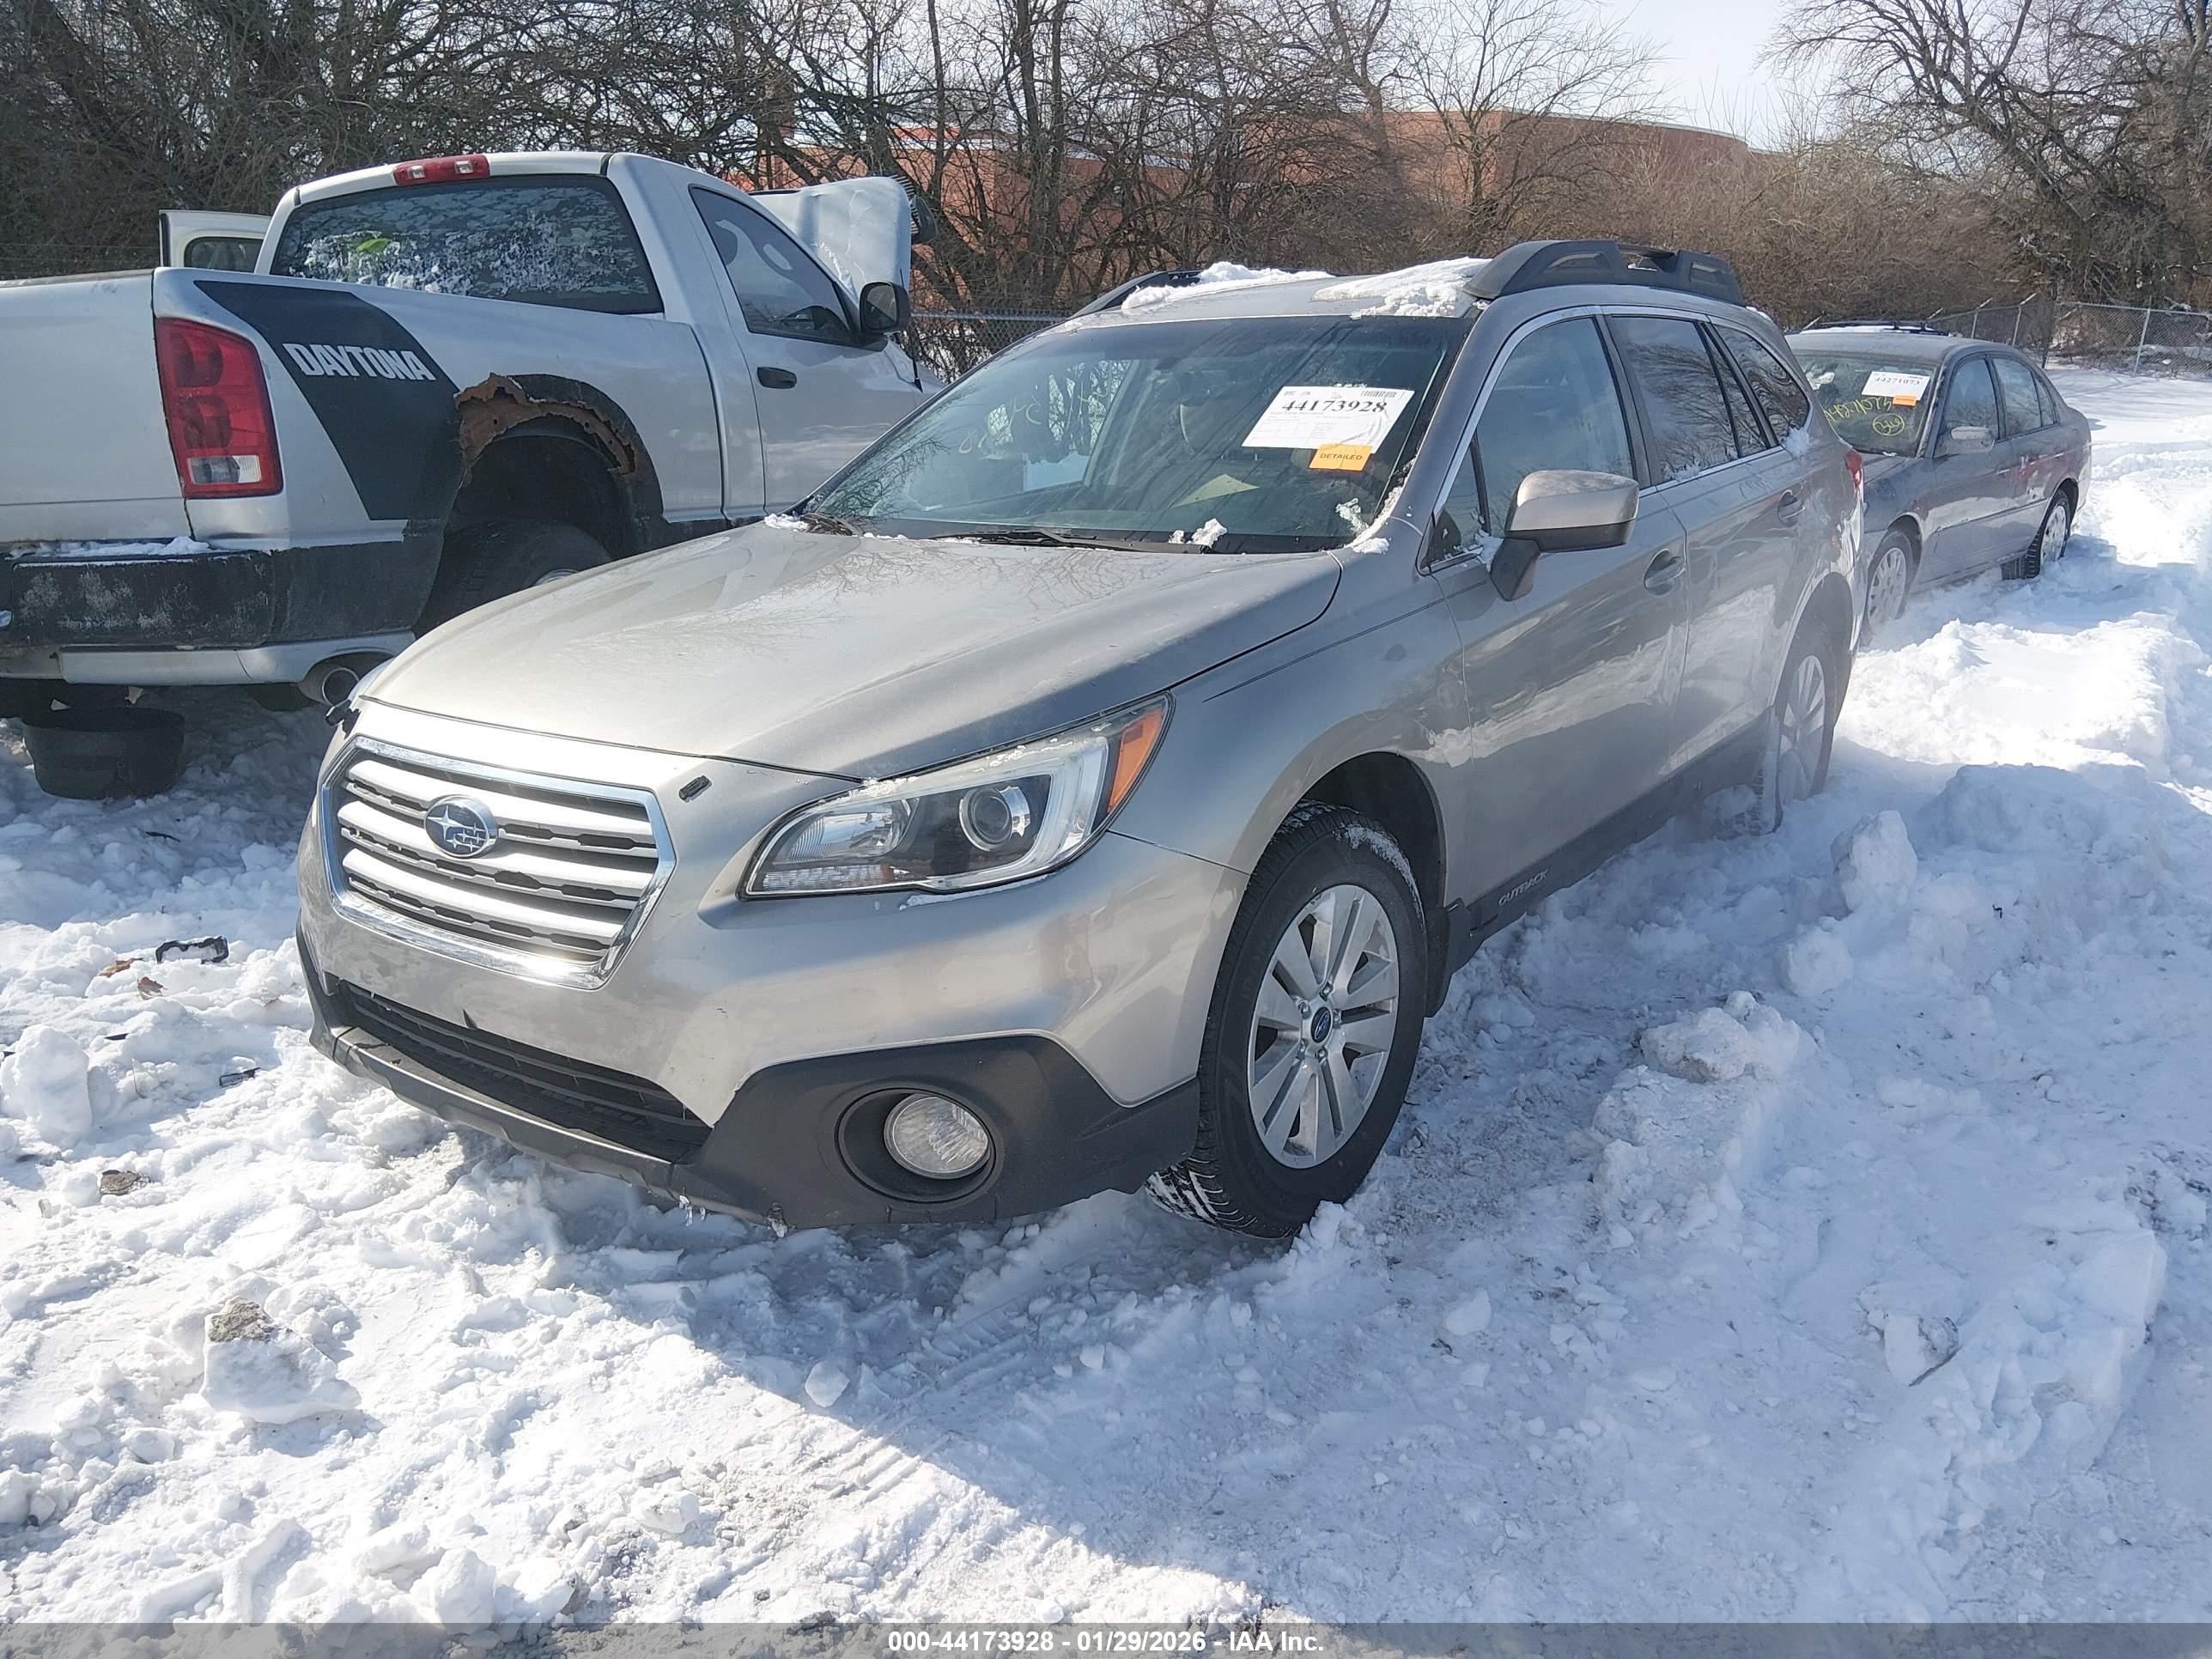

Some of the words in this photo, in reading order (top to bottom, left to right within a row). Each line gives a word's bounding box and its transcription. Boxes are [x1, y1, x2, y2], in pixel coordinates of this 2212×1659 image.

[283, 343, 437, 380] DAYTONA
[1281, 399, 1388, 413] 44173928
[1319, 453, 1364, 461] DETAILED
[1498, 869, 1548, 906] OUTBACK
